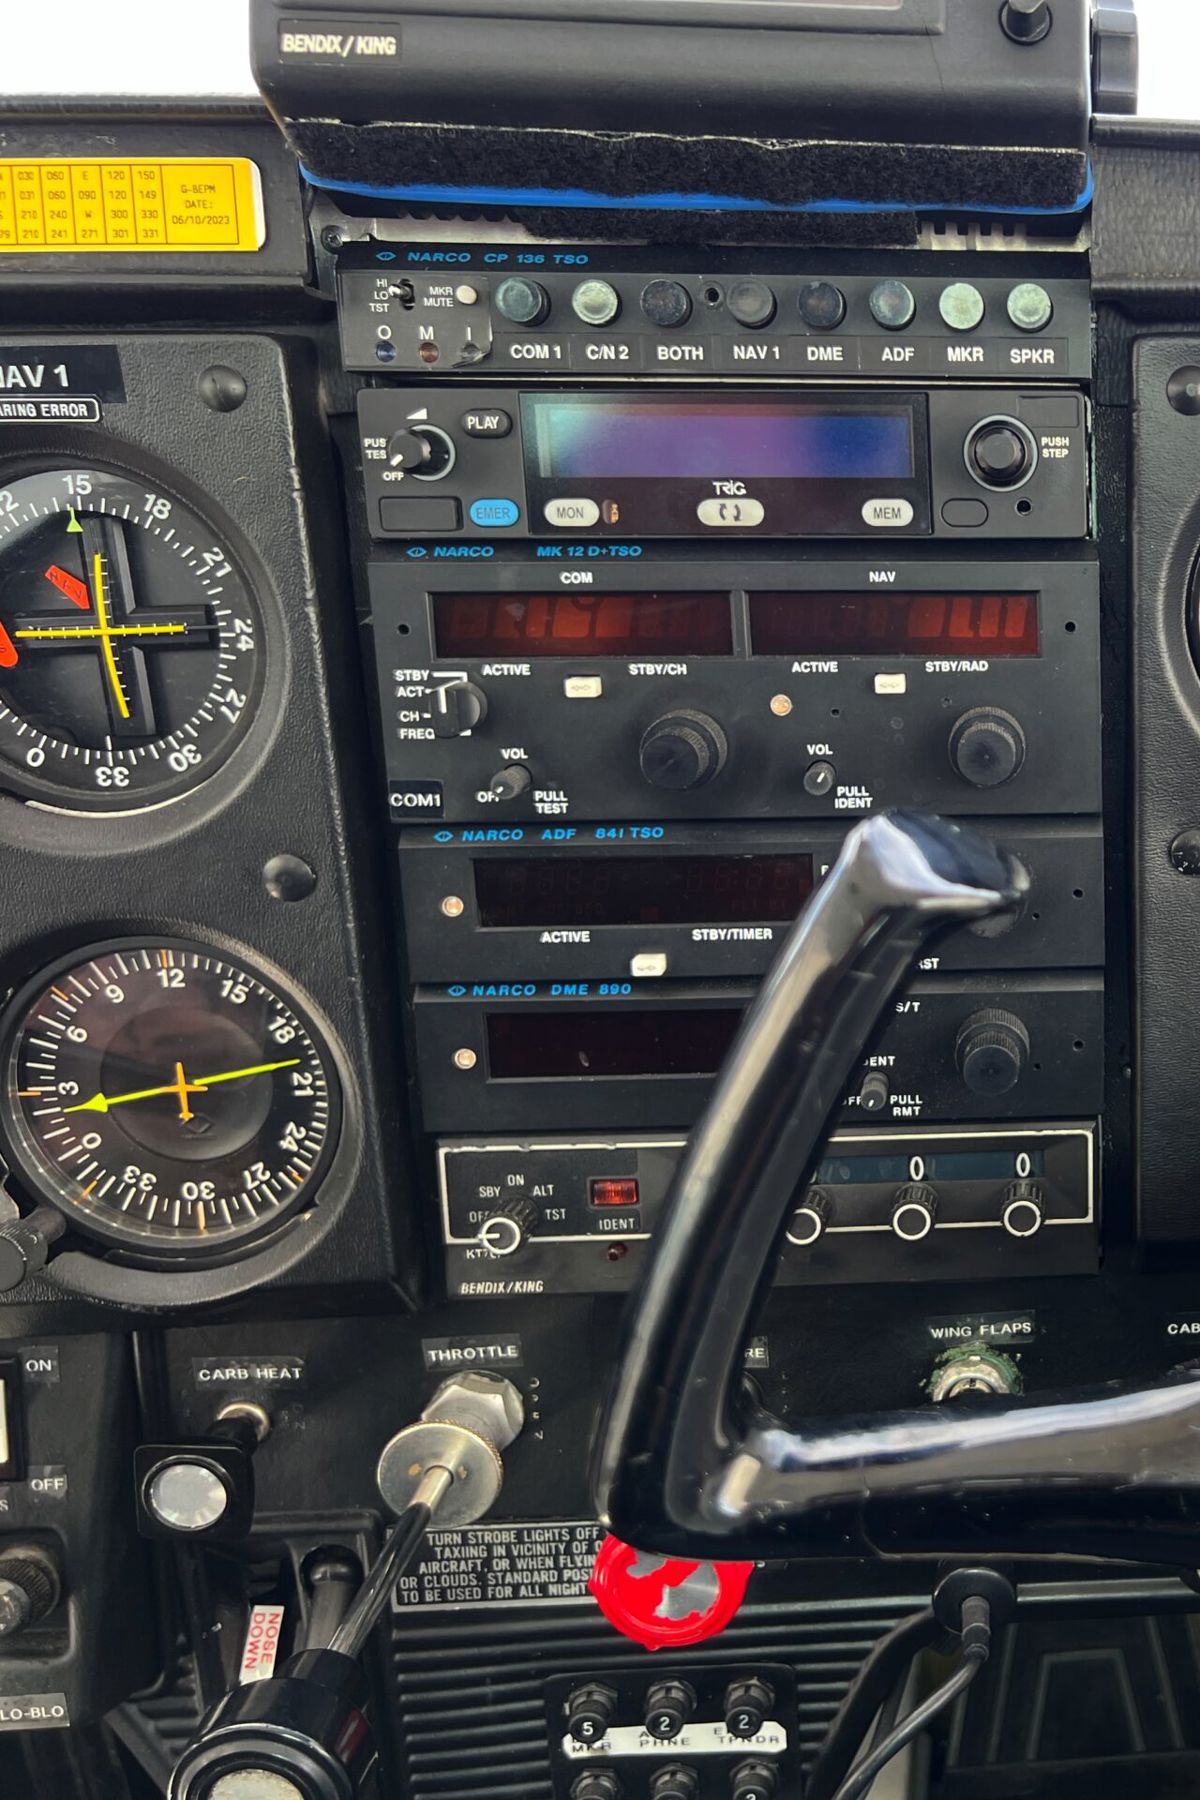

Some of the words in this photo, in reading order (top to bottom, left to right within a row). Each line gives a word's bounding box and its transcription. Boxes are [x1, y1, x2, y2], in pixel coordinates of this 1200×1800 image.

[282, 34, 396, 58] BENDIX/KING
[180, 184, 216, 194] G-BEPM
[50, 210, 68, 220] 240
[111, 210, 128, 219] 300
[142, 210, 158, 219] 330
[51, 230, 68, 238] 241
[82, 230, 98, 238] 271
[112, 230, 129, 238] 301
[143, 230, 159, 238] 331
[408, 252, 472, 262] NARCO
[484, 254, 508, 263] CP
[516, 254, 545, 264] 136
[553, 254, 588, 264] TSO
[376, 278, 388, 288] HI
[374, 291, 388, 300] LO
[429, 286, 454, 296] MKR
[369, 303, 390, 312] TST
[424, 297, 454, 307] MUTE
[587, 345, 618, 360] C/N
[620, 346, 630, 359] 2
[658, 346, 704, 360] BOTH
[807, 346, 844, 361] DME
[882, 348, 914, 362] ADF
[947, 347, 984, 362] MKR
[1010, 349, 1055, 364] SPKR
[40, 403, 88, 417] ERROR
[468, 416, 500, 431] PLAY
[1041, 436, 1070, 447] PUSH
[1042, 448, 1069, 458] STEP
[382, 472, 404, 481] OFF
[62, 474, 92, 496] 15
[144, 494, 172, 520] 18
[476, 506, 511, 520] EMER
[556, 506, 584, 520] MON
[873, 507, 902, 520] MEM
[202, 546, 232, 577] 21
[560, 572, 593, 584] COM
[869, 571, 896, 582] NAV
[234, 618, 255, 652] 24
[482, 664, 530, 676] ACTIVE
[628, 664, 687, 676] STBY/CH
[792, 661, 838, 672] ACTIVE
[926, 660, 988, 672] STBY/RAD
[394, 670, 430, 681] STBY
[220, 688, 246, 724] 27
[400, 711, 420, 722] CH
[399, 728, 436, 740] FREQ
[502, 748, 528, 760] VOL
[806, 744, 833, 755] VOL
[168, 744, 202, 772] 30
[96, 766, 130, 787] 33
[534, 790, 568, 802] PULL
[837, 786, 870, 797] PULL
[390, 794, 441, 807] COM1
[834, 798, 873, 809] IDENT
[535, 803, 568, 814] TEST
[462, 830, 524, 842] NARCO
[542, 829, 576, 840] ADF
[630, 828, 664, 839] TSO
[540, 931, 590, 944] ACTIVE
[692, 928, 773, 941] STBY/TIMER
[156, 968, 186, 988] 12
[220, 979, 249, 1004] 15
[473, 984, 536, 997] NARCO
[552, 984, 588, 996] DME
[600, 984, 632, 995] 890
[268, 1015, 296, 1044] 18
[890, 1095, 922, 1105] PULL
[893, 1106, 920, 1116] RMT
[508, 1174, 524, 1187] ON
[480, 1186, 500, 1198] SBY
[532, 1184, 554, 1196] ALT
[546, 1208, 566, 1220] TST
[600, 1218, 635, 1231] IDENT
[460, 1280, 544, 1295] BENDIX/KING
[931, 1326, 972, 1338] WING
[979, 1322, 1032, 1336] FLAPS
[428, 1344, 518, 1362] THROTTLE
[26, 1360, 52, 1372] ON
[199, 1368, 249, 1380] CARB
[256, 1368, 302, 1379] HEAT
[31, 1478, 64, 1492] OFF
[426, 1532, 462, 1546] TURN
[468, 1530, 518, 1544] STROBE
[524, 1528, 570, 1542] LIGHTS
[576, 1527, 600, 1540] OFF
[434, 1546, 488, 1560] TAXIING
[494, 1544, 506, 1556] IN
[512, 1542, 566, 1556] VICINITY
[572, 1541, 589, 1554] OF
[492, 1559, 510, 1570] OR
[516, 1556, 554, 1570] WHEN
[560, 1554, 596, 1568] FLYIN
[400, 1576, 418, 1590] OR
[488, 1570, 558, 1585] STANDARD
[402, 1590, 419, 1604] TO
[425, 1588, 442, 1602] BE
[447, 1586, 482, 1600] USED
[488, 1586, 513, 1598] FOR
[520, 1584, 543, 1596] ALL
[244, 1612, 266, 1670] DOWN
[260, 1612, 281, 1664] NOSE
